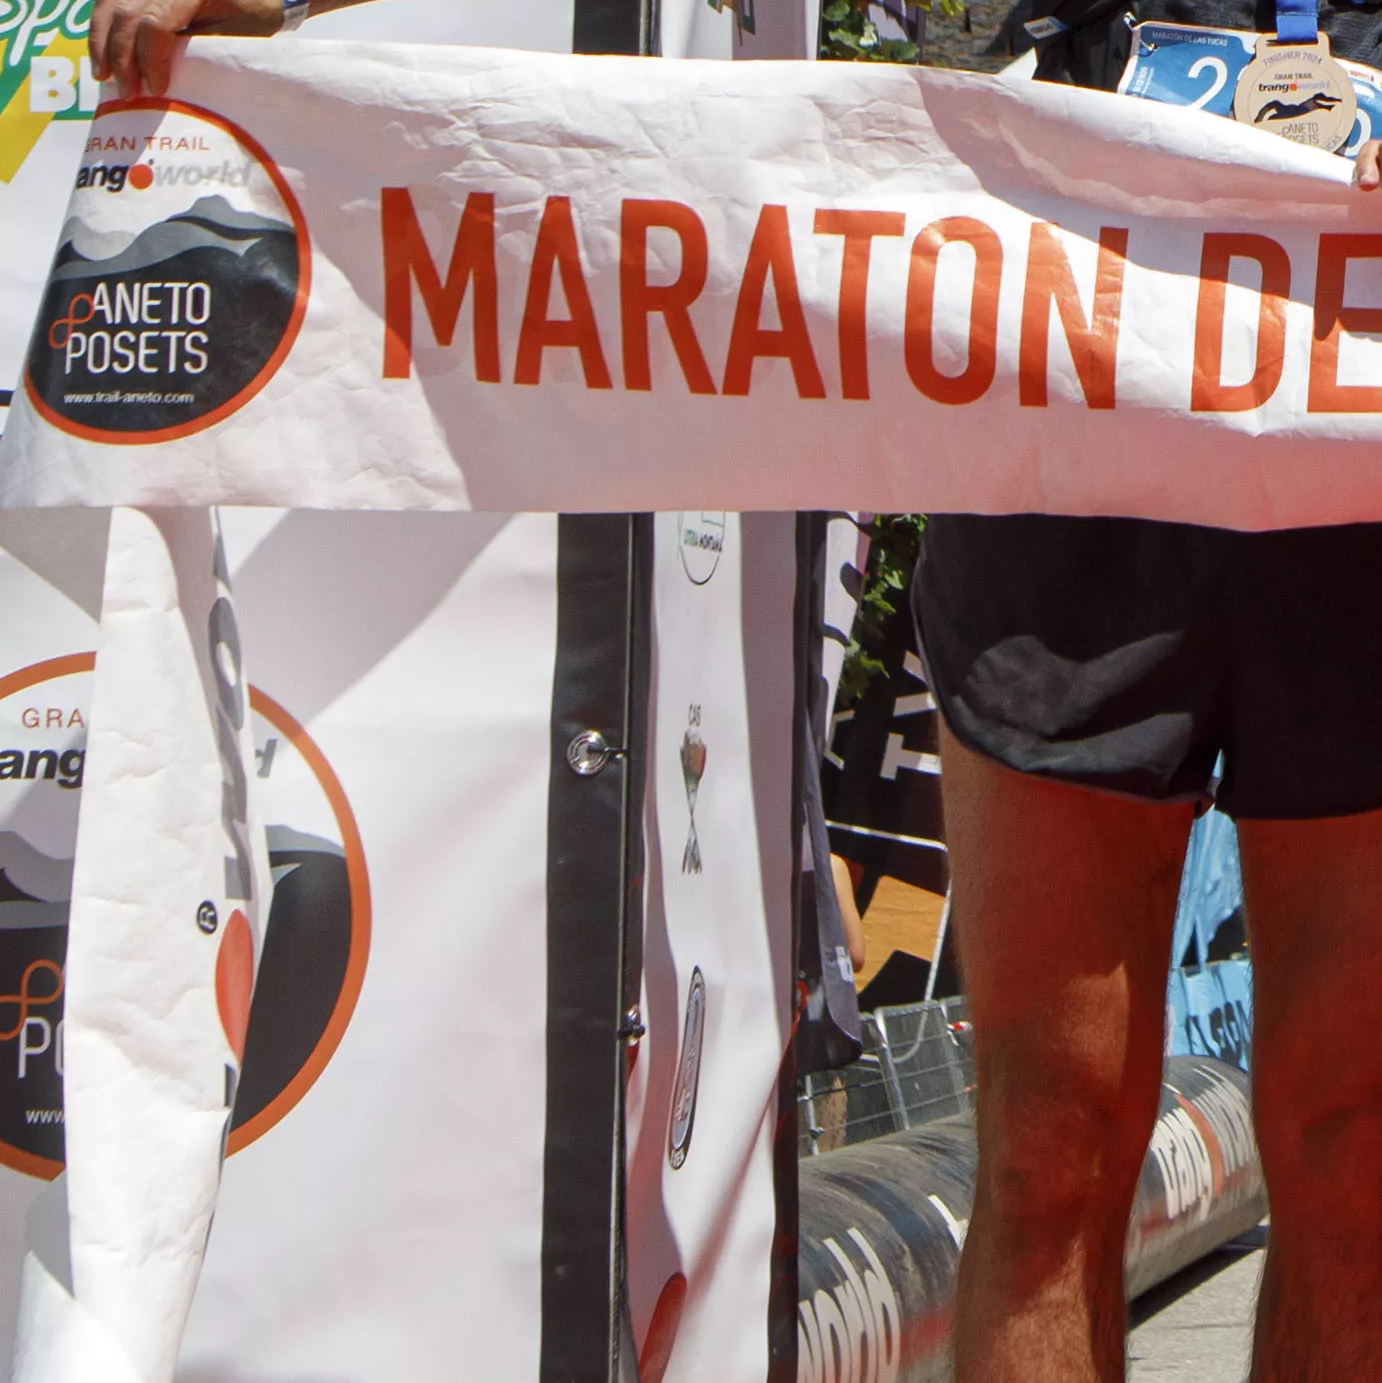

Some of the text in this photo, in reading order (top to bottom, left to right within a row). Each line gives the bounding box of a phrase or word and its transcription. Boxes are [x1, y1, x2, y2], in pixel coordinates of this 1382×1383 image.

[147, 136, 210, 151] TRAIL
[92, 282, 212, 326] ANETO
[380, 186, 1130, 410] MARATON
[64, 331, 209, 376] POSETS
